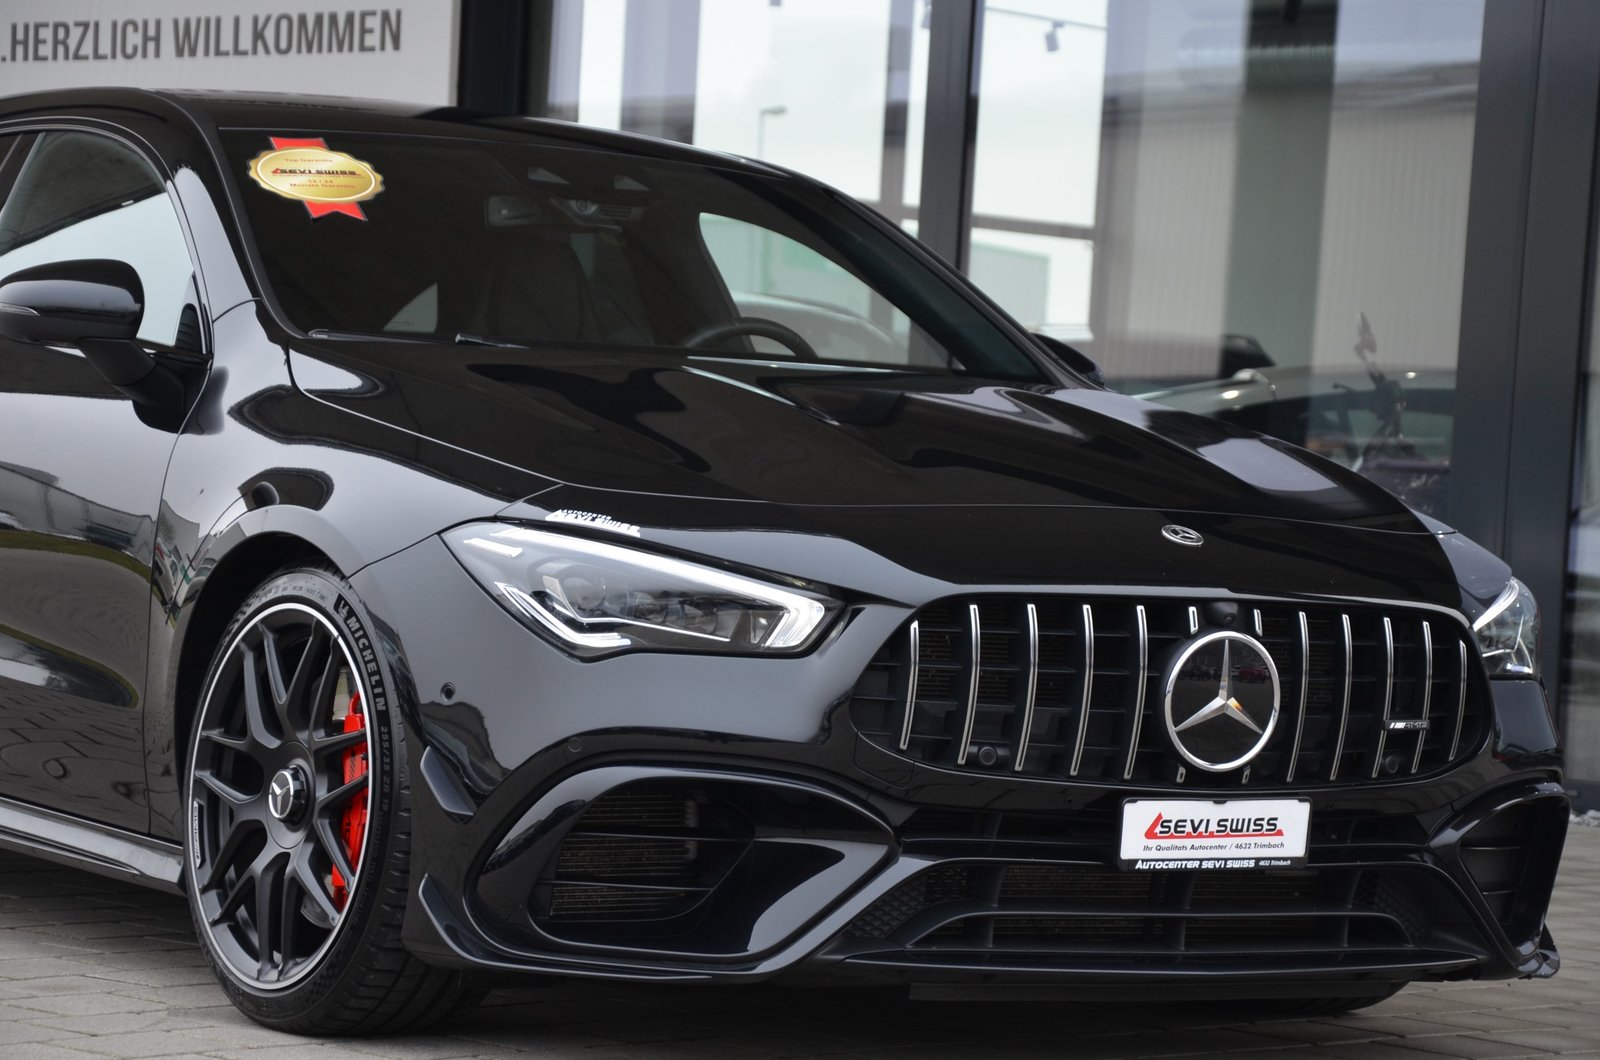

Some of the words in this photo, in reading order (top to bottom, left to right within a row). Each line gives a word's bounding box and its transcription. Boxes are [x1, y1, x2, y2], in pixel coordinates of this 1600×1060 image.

[172, 9, 402, 57] WILLKOMMEN
[562, 509, 612, 521] AUTOCENTER
[346, 614, 386, 712] MICHELIN
[1158, 818, 1211, 835] SEVI
[1216, 817, 1279, 834] SWISS
[1143, 844, 1153, 852] Ihr
[1190, 843, 1228, 851] Autocenter
[1254, 842, 1285, 850] Trimbach
[1135, 860, 1199, 870] AUTOCENTER
[1201, 860, 1225, 869] SEVI
[1226, 859, 1256, 869] SWISS
